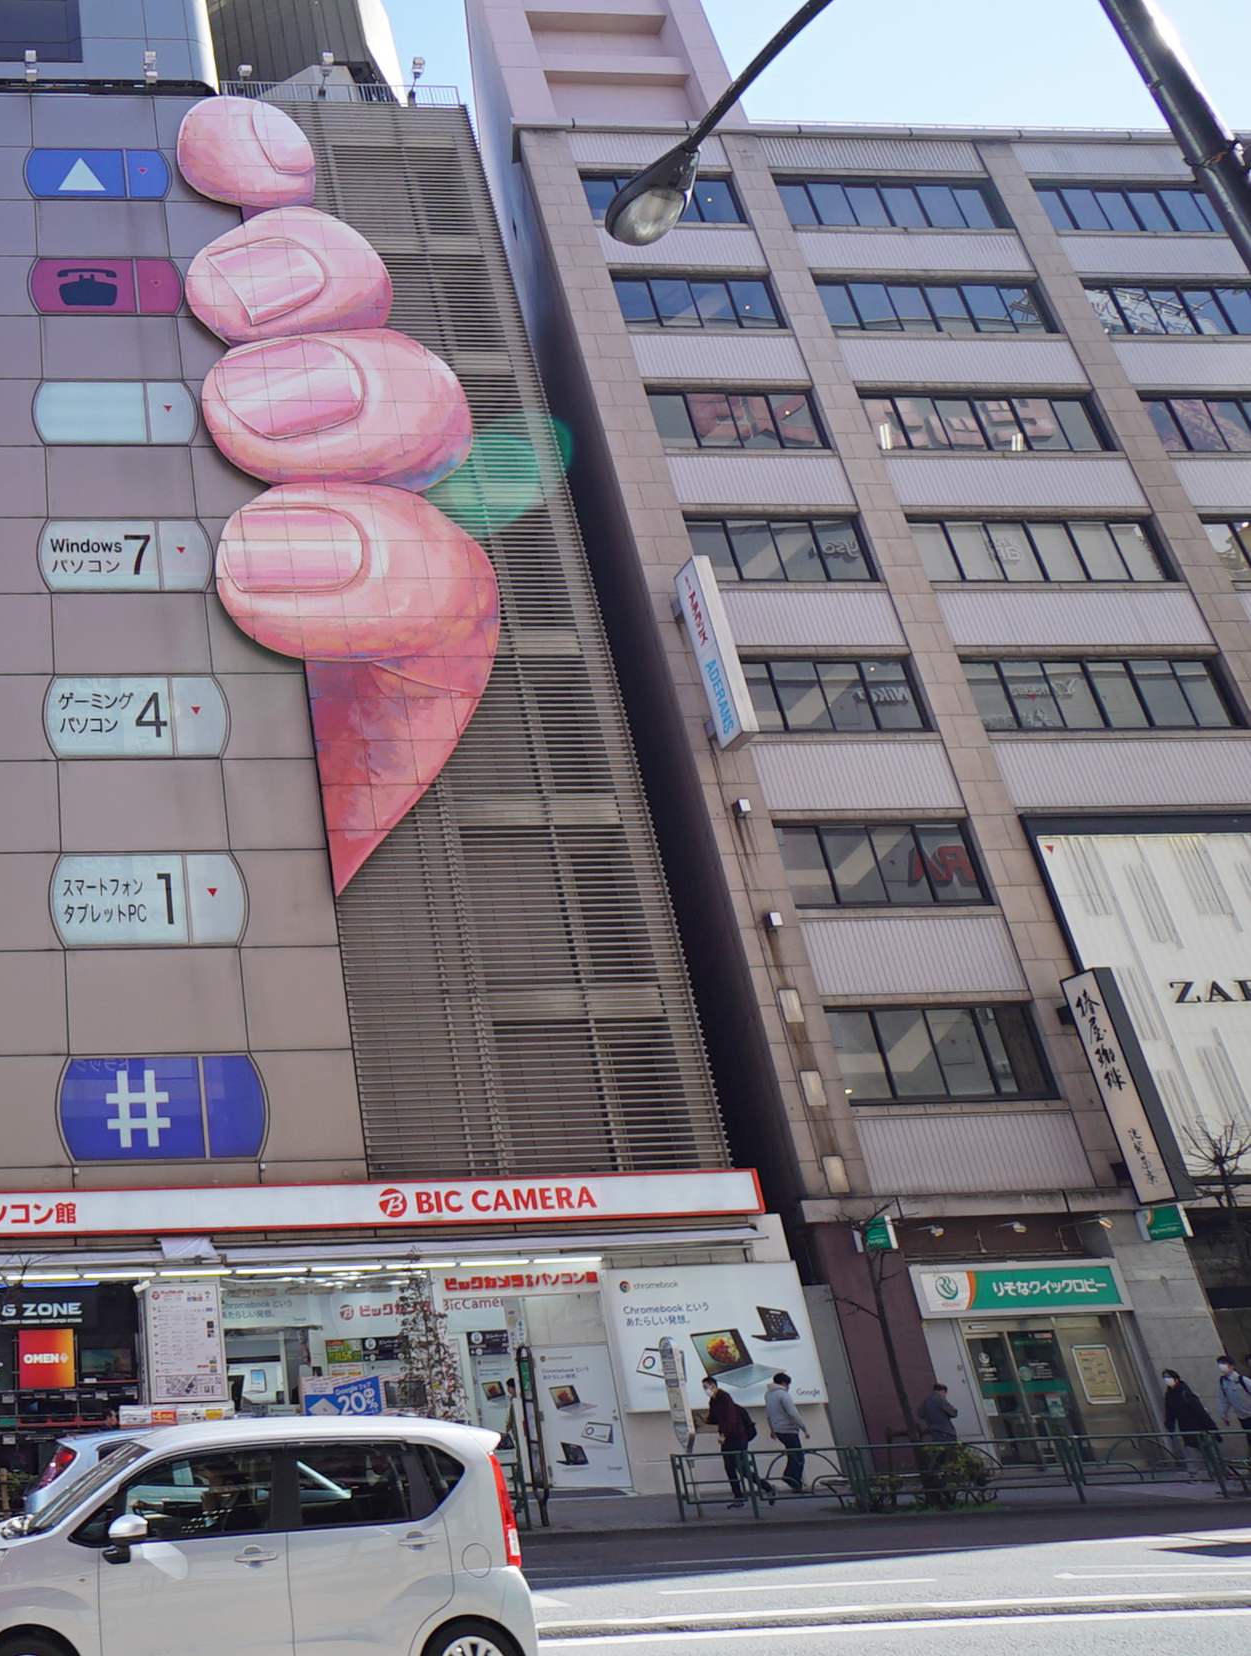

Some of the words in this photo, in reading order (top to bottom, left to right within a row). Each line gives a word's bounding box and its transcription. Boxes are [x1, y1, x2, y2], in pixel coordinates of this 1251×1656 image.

[50, 538, 122, 553] Windows
[124, 535, 151, 575] 7
[52, 559, 120, 574] パソコン
[59, 692, 134, 710] ゲーミング
[705, 658, 734, 735] ADERANS
[136, 692, 167, 738] 4
[60, 717, 118, 734] パソコン
[63, 877, 143, 896] スマートフォン
[157, 873, 175, 925] 1
[64, 904, 147, 924] タブレットPC
[415, 1190, 464, 1214] BIC
[471, 1186, 597, 1212] CAMERA
[633, 1281, 679, 1290] chromebook
[993, 1278, 1107, 1297] りそなクイックロビー
[22, 1302, 83, 1318] ZONE
[623, 1304, 684, 1315] Chromebook
[686, 1302, 709, 1312] という
[23, 1353, 59, 1364] OMEN
